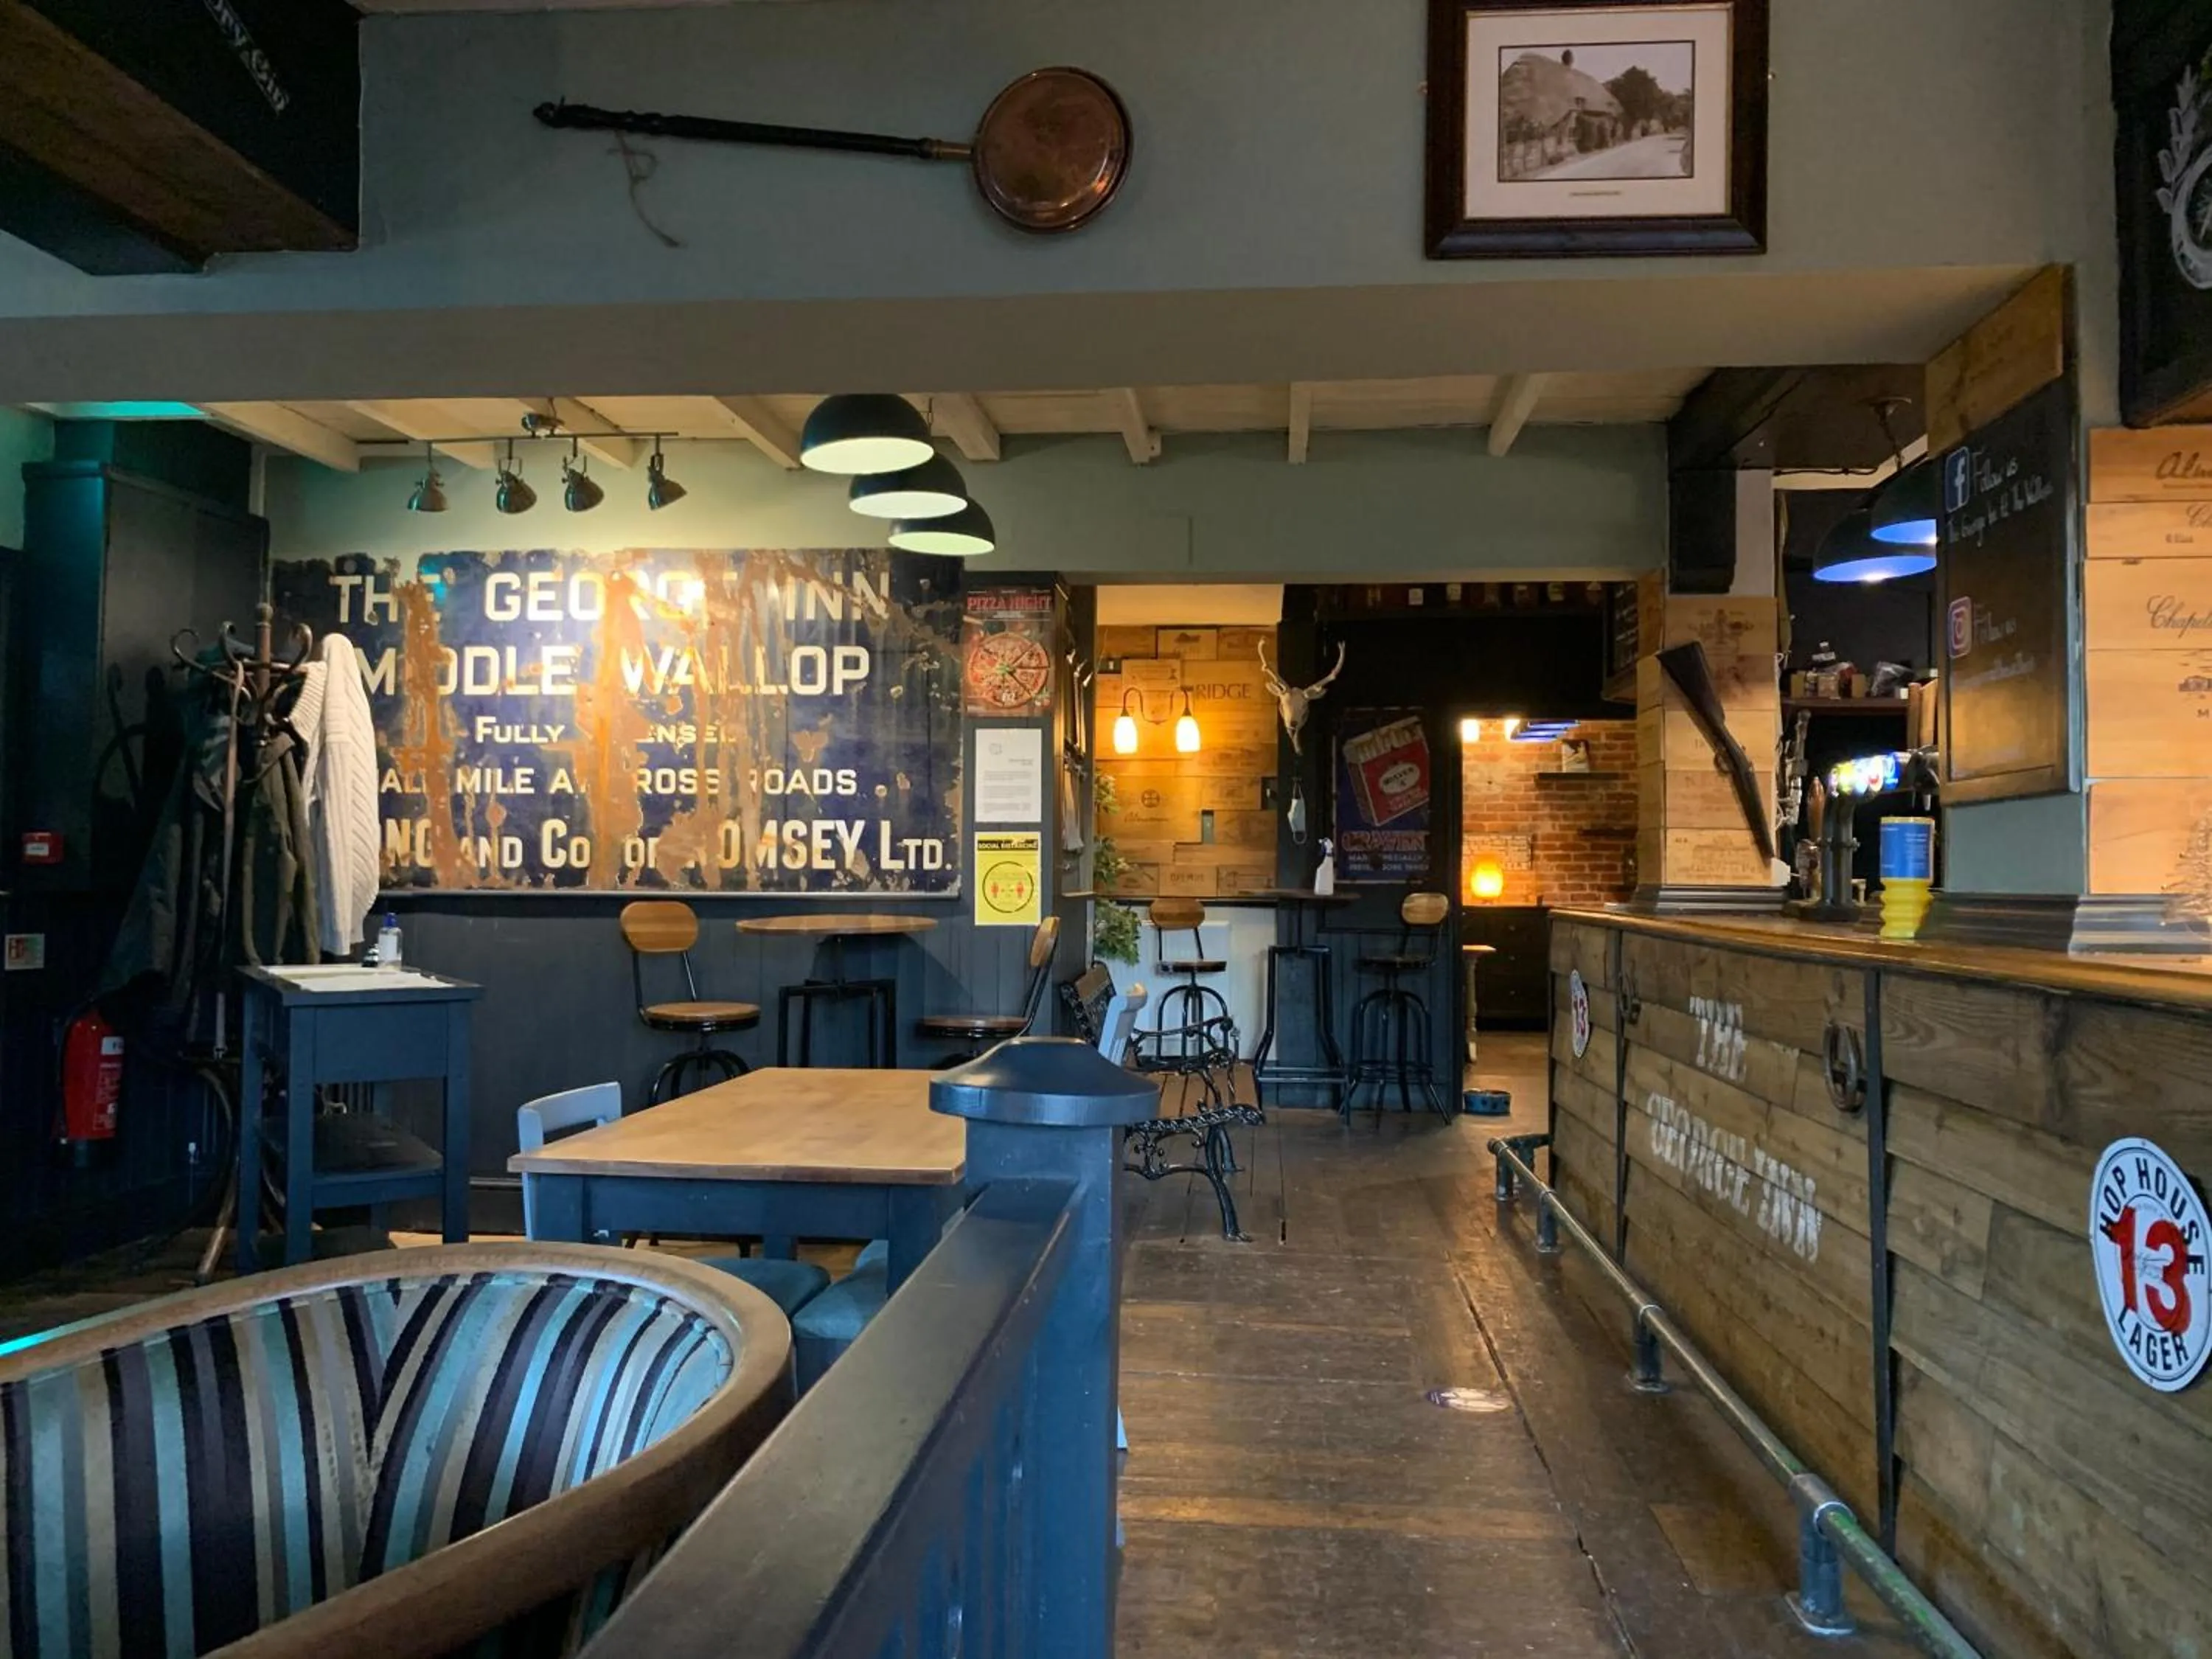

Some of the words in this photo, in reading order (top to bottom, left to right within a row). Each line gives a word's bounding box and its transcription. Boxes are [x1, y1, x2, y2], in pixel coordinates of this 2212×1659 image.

[484, 571, 738, 622] GEORG
[785, 571, 890, 621] INN
[967, 595, 1006, 611] PIZZA
[1009, 594, 1052, 611] NIGHT
[355, 645, 579, 696] MDDLE
[619, 645, 870, 696] WALLOP
[456, 768, 535, 794] MILE
[635, 768, 720, 794] ROSS
[459, 836, 524, 869] AND
[685, 818, 866, 870] OMSEY
[1689, 995, 1747, 1082] THE
[1646, 1091, 1750, 1217] GEORGE
[1754, 1147, 1822, 1264] INN
[2099, 1165, 2127, 1242] HOP
[2135, 1156, 2205, 1276] HOUSE
[2110, 1204, 2193, 1337] 13
[2118, 1307, 2190, 1371] LAGER
